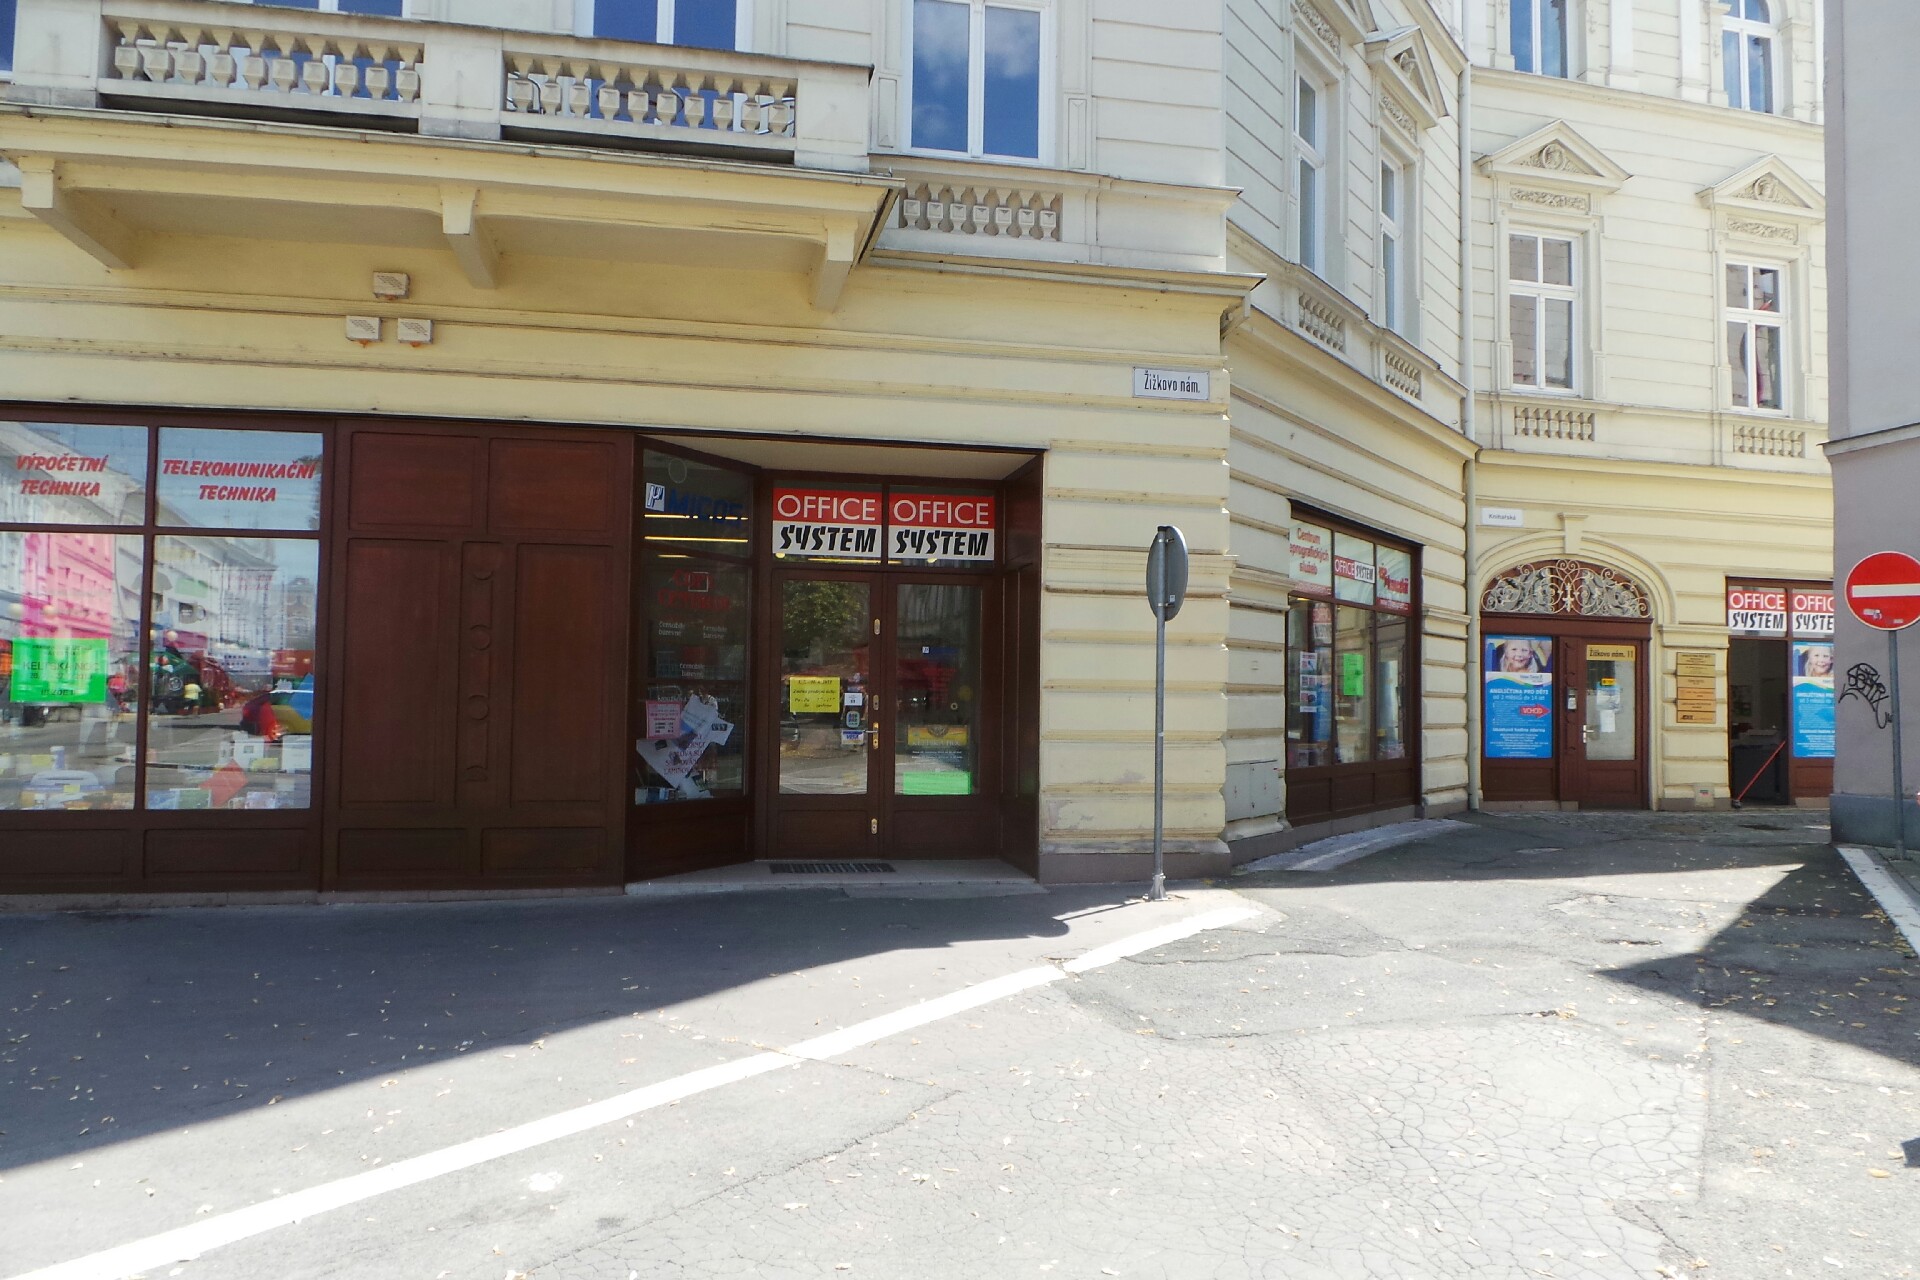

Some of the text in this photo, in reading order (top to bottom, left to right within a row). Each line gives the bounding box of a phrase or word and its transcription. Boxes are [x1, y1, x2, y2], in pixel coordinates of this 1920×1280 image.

[1144, 370, 1200, 393] Žižkovo nám.
[16, 453, 109, 473] VÝPOČETNÍ
[163, 459, 317, 479] TELEKOMUNIKAČNÍ
[20, 480, 102, 497] TECHNIKA
[199, 485, 277, 503] TECHNIKA
[777, 494, 876, 521] OFFICE
[893, 499, 990, 525] OFFICE
[780, 524, 877, 553] SYSTEM
[895, 529, 990, 556] SYSTEM
[1334, 559, 1355, 577] OFFICE
[1729, 592, 1785, 610] OFFICE
[1794, 594, 1834, 612] OFFIC
[1732, 612, 1784, 629] SYSTEM
[1795, 616, 1834, 631] SYSTE
